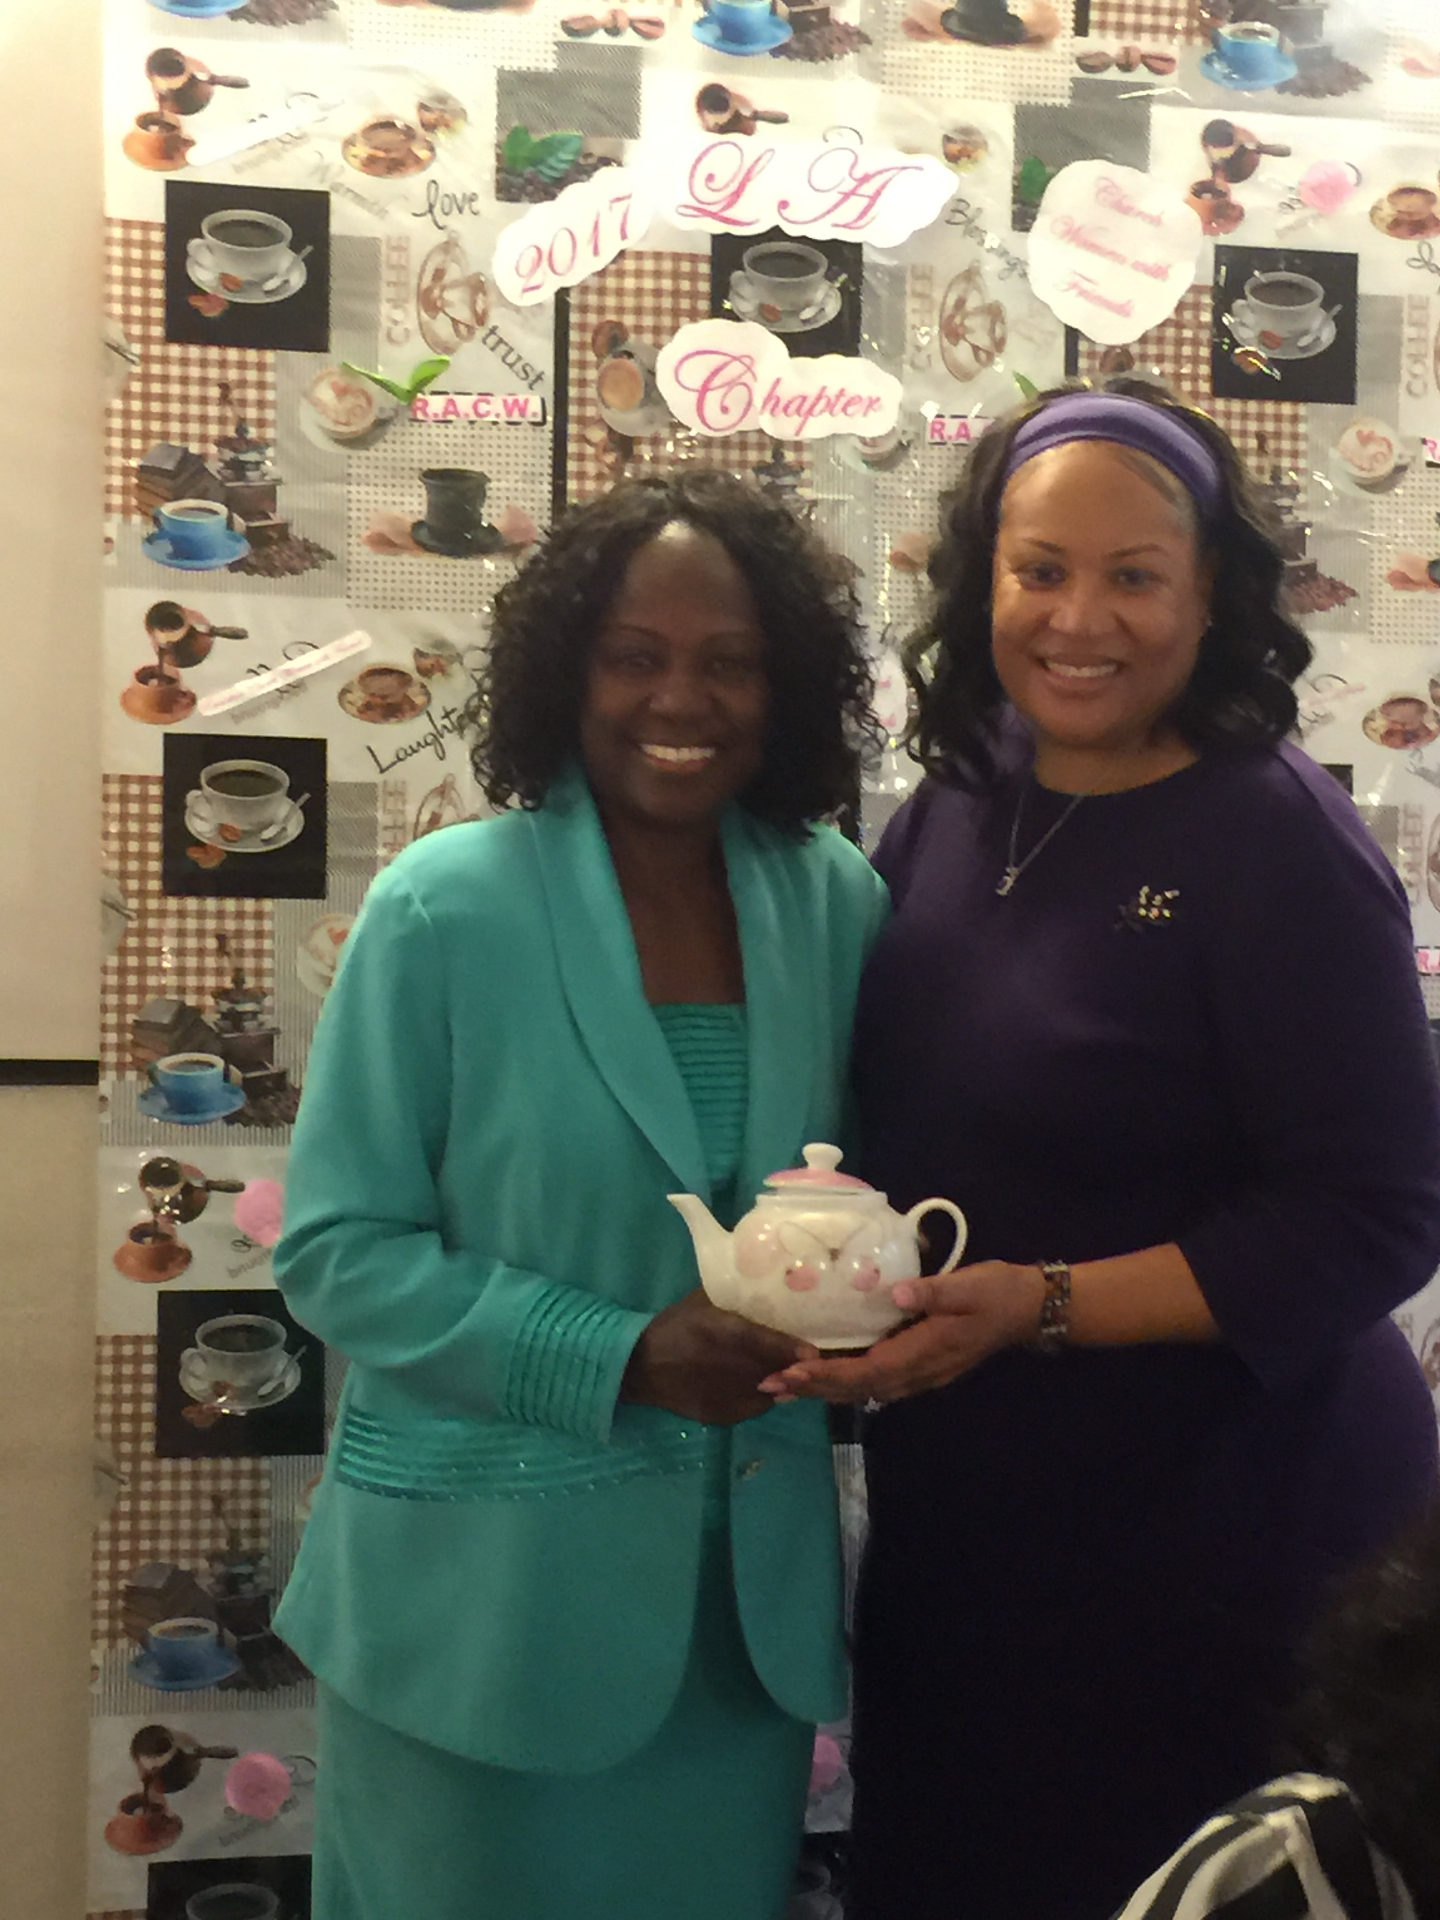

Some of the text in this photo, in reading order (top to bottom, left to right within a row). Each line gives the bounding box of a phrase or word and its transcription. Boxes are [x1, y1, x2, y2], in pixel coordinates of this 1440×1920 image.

[411, 179, 480, 230] love
[515, 191, 632, 299] 2017
[482, 325, 545, 390] trust
[411, 398, 539, 418] R.A.C.W.
[675, 350, 882, 436] Chapter
[366, 705, 466, 774] Laught
